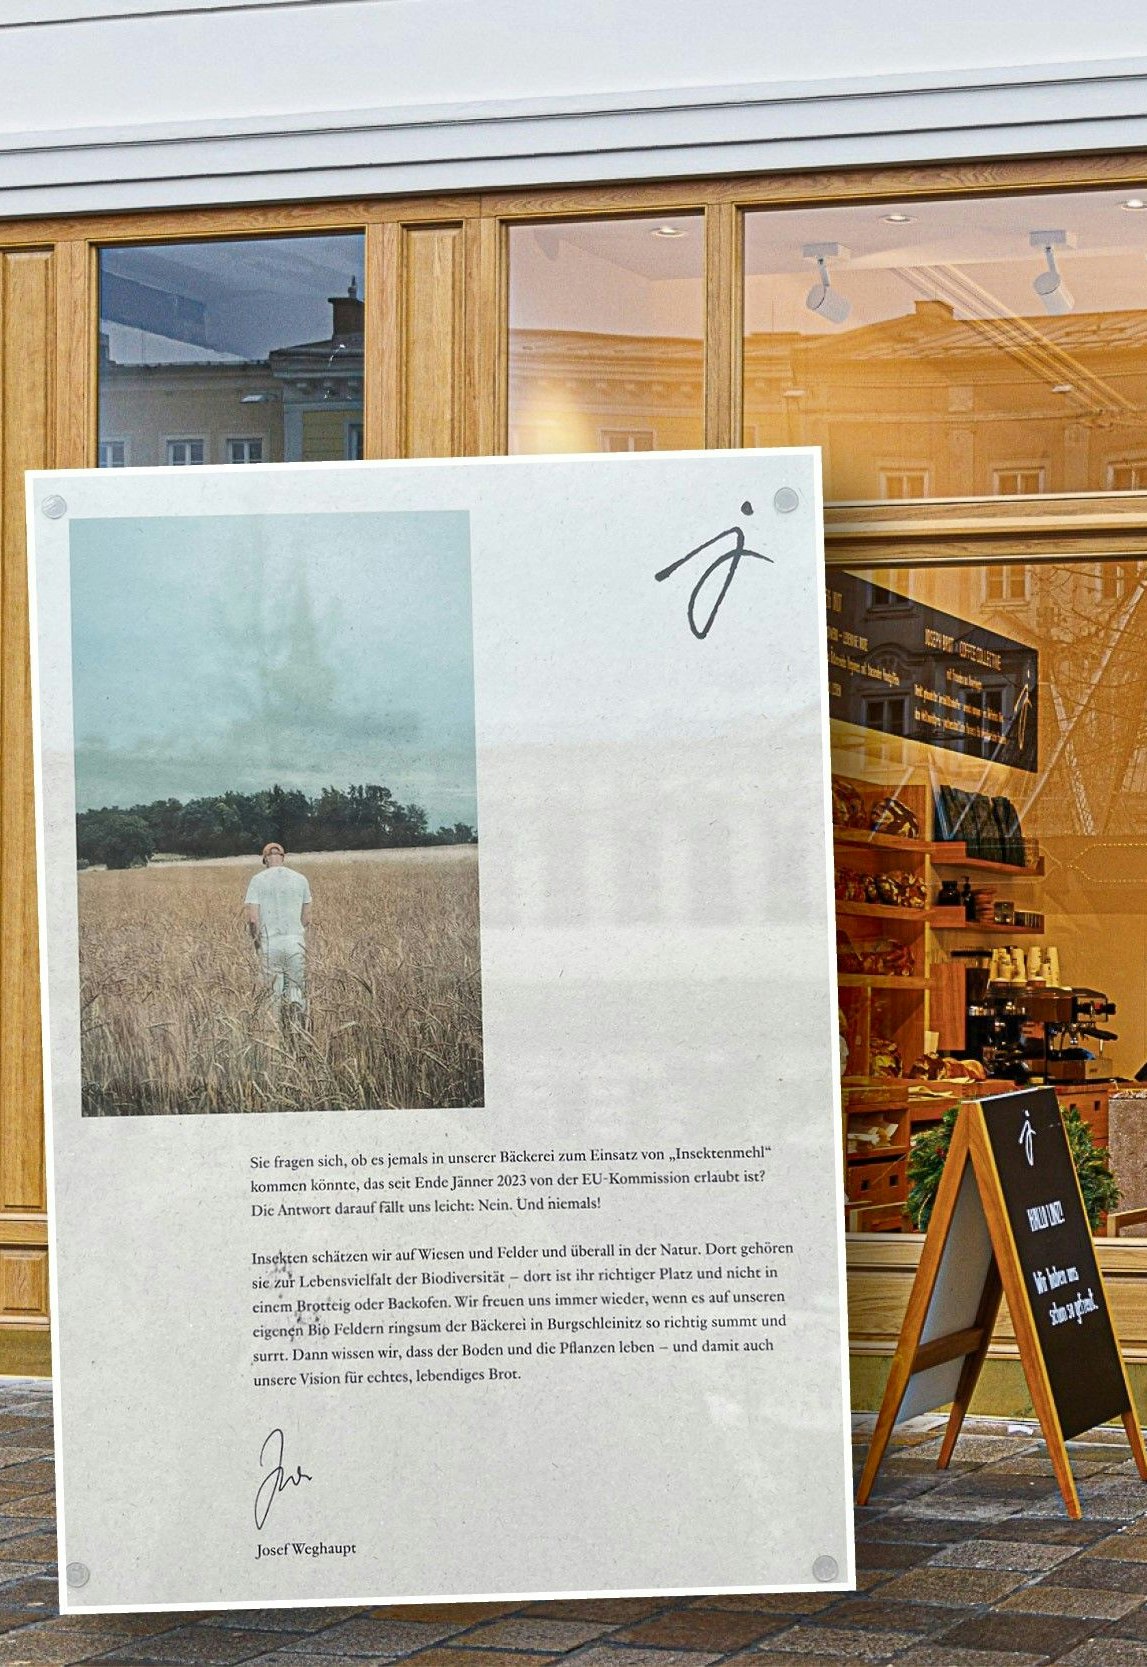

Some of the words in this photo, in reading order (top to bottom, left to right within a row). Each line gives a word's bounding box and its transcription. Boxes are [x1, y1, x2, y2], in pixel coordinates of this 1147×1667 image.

[249, 1156, 271, 1169] Sie
[274, 1155, 315, 1171] fragen
[317, 1153, 348, 1169] sich,
[350, 1153, 368, 1167] ob
[370, 1157, 385, 1167] es
[387, 1152, 429, 1168] jemals
[431, 1152, 445, 1165] in
[447, 1154, 497, 1165] unserer
[499, 1149, 555, 1163] Bäckerei
[558, 1152, 588, 1162] zum
[589, 1148, 639, 1161] Einsatz
[640, 1151, 665, 1161] von
[250, 1179, 307, 1193] kommen
[310, 1178, 361, 1193] könnte,
[363, 1177, 385, 1191] das
[387, 1176, 412, 1191] seit
[414, 1174, 449, 1189] Ende
[449, 1175, 495, 1192] Jänner
[496, 1174, 527, 1187] 2023
[529, 1176, 554, 1186] von
[556, 1173, 580, 1186] der
[581, 1171, 691, 1185] EU-Kommission
[693, 1169, 740, 1184] erlaubt
[743, 1169, 766, 1183] ist?
[250, 1203, 275, 1217] Die
[276, 1204, 332, 1217] Antwort
[334, 1201, 378, 1215] darauf
[378, 1200, 405, 1214] fällt
[408, 1203, 432, 1213] uns
[434, 1199, 475, 1212] leicht:
[477, 1198, 513, 1212] Nein.
[515, 1196, 545, 1211] Und
[547, 1196, 601, 1210] niemals!
[250, 1250, 309, 1267] Insekten
[311, 1249, 369, 1264] schätzen
[371, 1249, 393, 1262] wir
[395, 1247, 417, 1261] auf
[417, 1247, 465, 1260] Wiesen
[468, 1245, 494, 1260] und
[496, 1245, 539, 1259] Felder
[541, 1244, 568, 1258] und
[570, 1244, 615, 1258] überall
[618, 1244, 632, 1257] in
[634, 1243, 658, 1256] der
[659, 1243, 702, 1257] Natur.
[704, 1243, 738, 1256] Dort
[740, 1241, 794, 1257] gehören
[251, 1276, 270, 1290] sie
[273, 1273, 296, 1289] zur
[299, 1273, 393, 1288] Lebensvielfalt
[395, 1271, 418, 1286] der
[420, 1270, 505, 1285] Biodiversität
[523, 1269, 552, 1283] dort
[555, 1269, 573, 1282] ist
[575, 1268, 595, 1282] ihr
[597, 1266, 657, 1283] richtiger
[659, 1267, 694, 1281] Platz
[696, 1266, 723, 1280] und
[726, 1265, 762, 1279] nicht
[765, 1265, 779, 1279] in
[251, 1300, 293, 1314] einem
[294, 1297, 351, 1314] Brotteig
[353, 1297, 385, 1311] oder
[387, 1296, 452, 1310] Backofen.
[453, 1295, 480, 1308] Wir
[482, 1294, 525, 1308] freuen
[527, 1296, 552, 1306] uns
[554, 1292, 599, 1306] immer
[599, 1291, 650, 1307] wieder,
[651, 1294, 688, 1305] wenn
[690, 1294, 706, 1304] es
[708, 1289, 732, 1304] auf
[732, 1292, 786, 1303] unseren
[252, 1323, 304, 1339] eigenen
[307, 1321, 331, 1335] Bio
[333, 1321, 385, 1336] Feldern
[388, 1320, 442, 1336] ringsum
[444, 1319, 468, 1333] der
[470, 1317, 527, 1333] Bäckerei
[530, 1317, 544, 1330] in
[547, 1315, 643, 1333] Burgschleinitz
[645, 1319, 661, 1329] so
[663, 1315, 708, 1330] richtig
[711, 1317, 758, 1328] summt
[761, 1313, 787, 1328] und
[252, 1352, 289, 1362] surrt.
[292, 1348, 329, 1361] Dann
[331, 1346, 375, 1360] wissen
[377, 1343, 403, 1361] wir,
[405, 1345, 434, 1358] dass
[436, 1343, 459, 1357] der
[461, 1342, 504, 1357] Boden
[507, 1341, 533, 1356] und
[535, 1341, 557, 1355] die
[559, 1341, 616, 1355] Pflanzen
[618, 1339, 655, 1354] leben
[672, 1339, 698, 1353] und
[701, 1338, 740, 1353] damit
[742, 1338, 775, 1352] auch
[253, 1376, 298, 1387] unsere
[298, 1371, 342, 1385] Vision
[344, 1370, 364, 1384] für
[366, 1370, 413, 1385] echtes,
[415, 1367, 486, 1384] lebendiges
[488, 1367, 522, 1380] Brot.
[255, 1542, 290, 1560] Josef
[292, 1541, 357, 1557] Weghaupt
